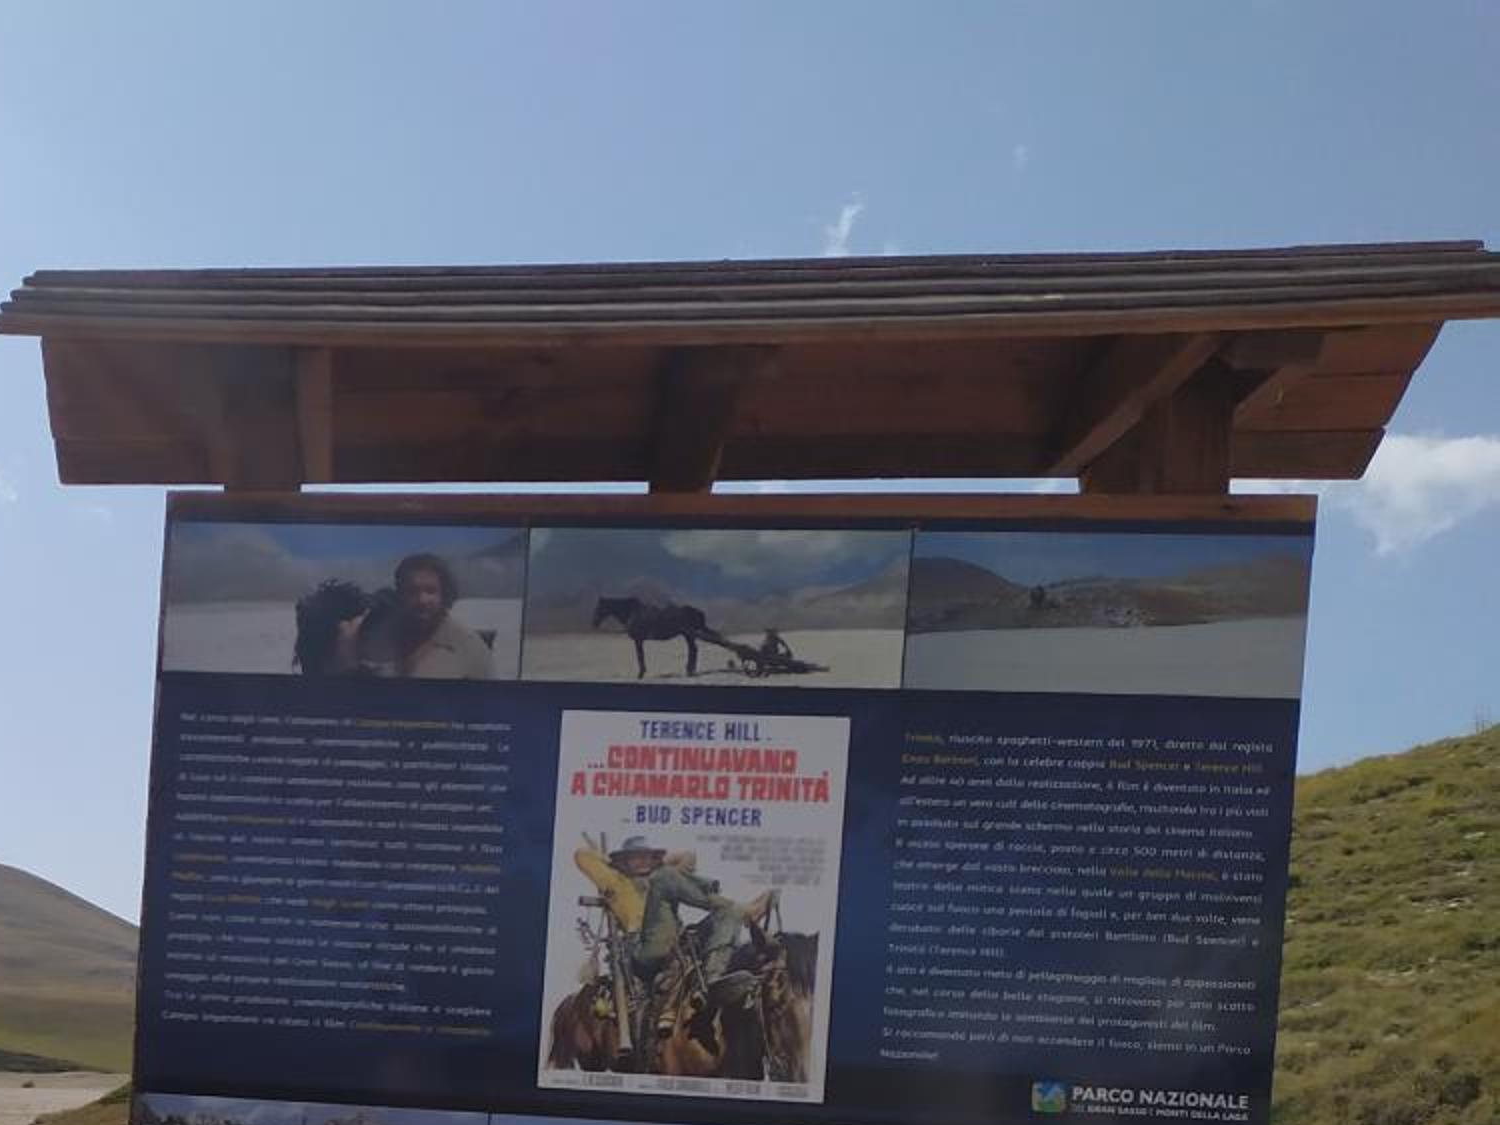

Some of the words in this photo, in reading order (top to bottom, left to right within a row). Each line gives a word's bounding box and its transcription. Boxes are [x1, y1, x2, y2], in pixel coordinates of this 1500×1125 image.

[640, 720, 717, 741] TERENCE
[723, 721, 762, 742] HILL
[570, 771, 587, 796] A
[592, 772, 731, 801] CHIAMARLO
[635, 805, 672, 824] BUD
[680, 806, 763, 827] SPENCER
[1072, 1086, 1134, 1104] PARCO
[1139, 1089, 1250, 1110] NAZIONALE
